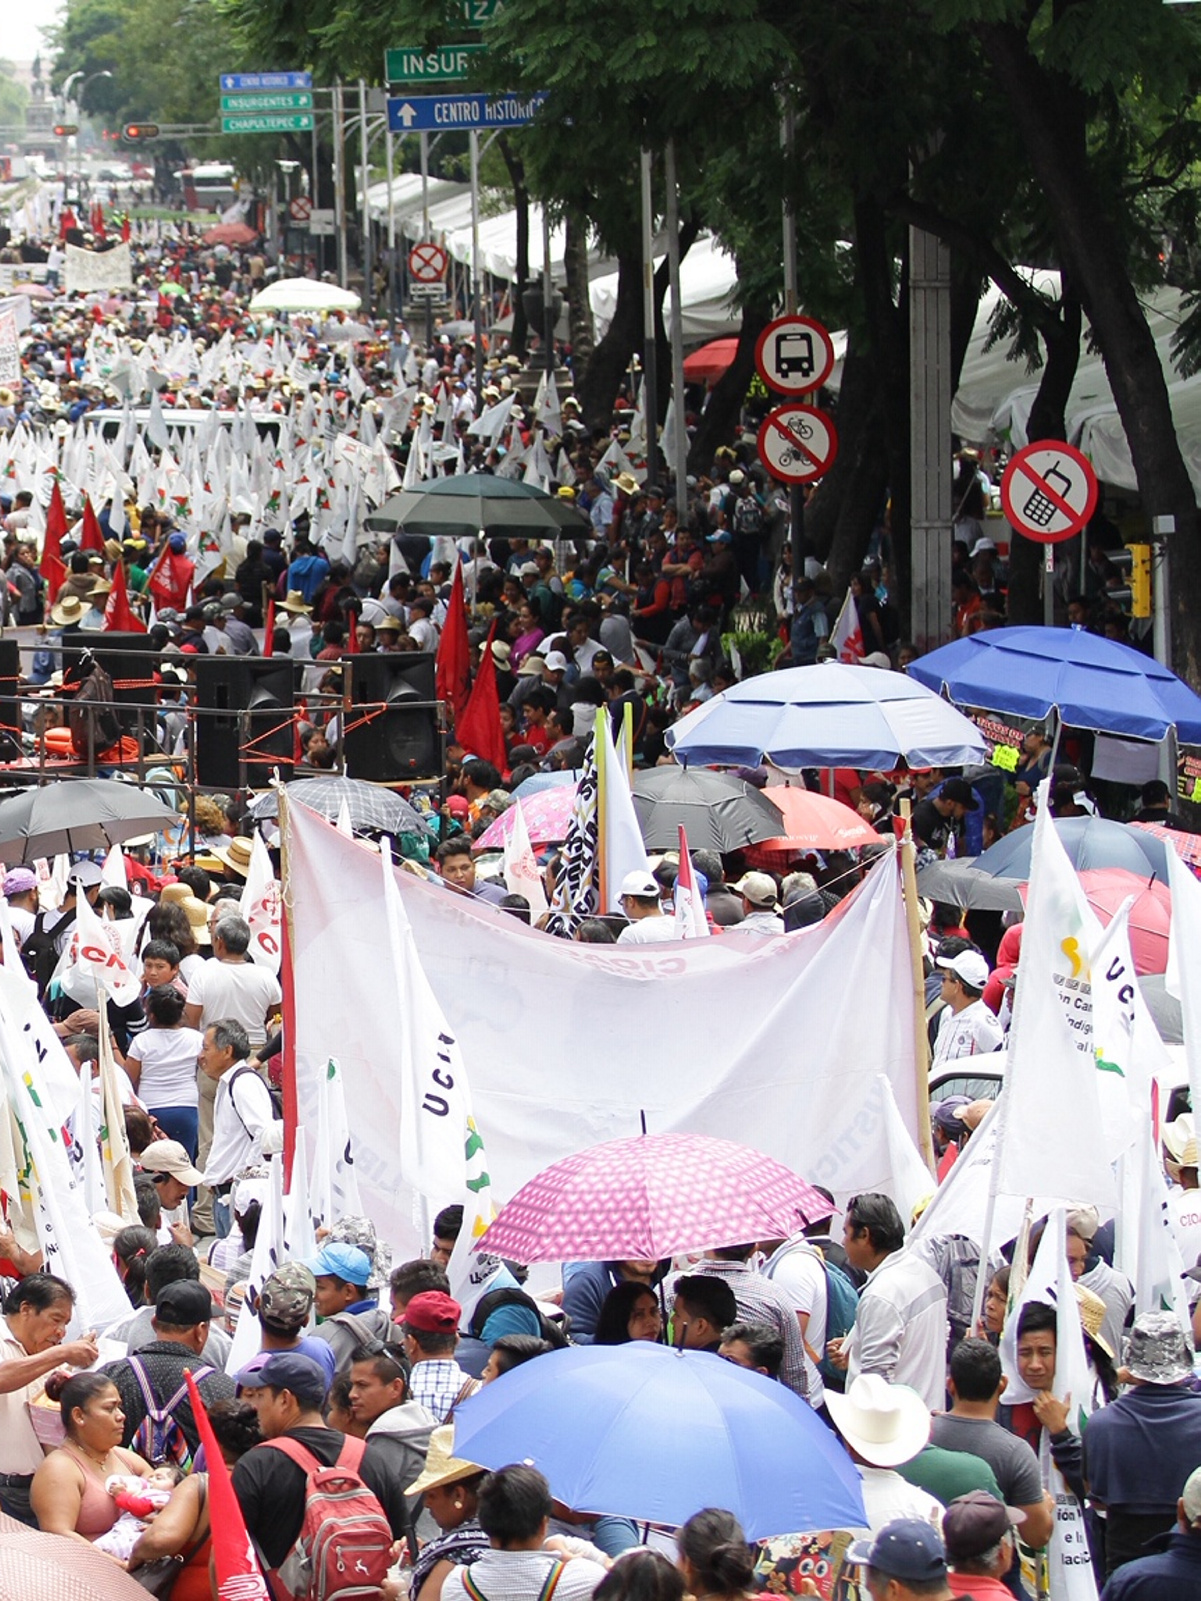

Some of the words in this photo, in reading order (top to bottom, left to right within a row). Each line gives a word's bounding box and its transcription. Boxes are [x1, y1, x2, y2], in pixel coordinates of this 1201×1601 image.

[228, 96, 294, 109] INSURGENTES
[434, 101, 480, 124] CENTRO
[229, 117, 295, 131] CHAPULTEPEC
